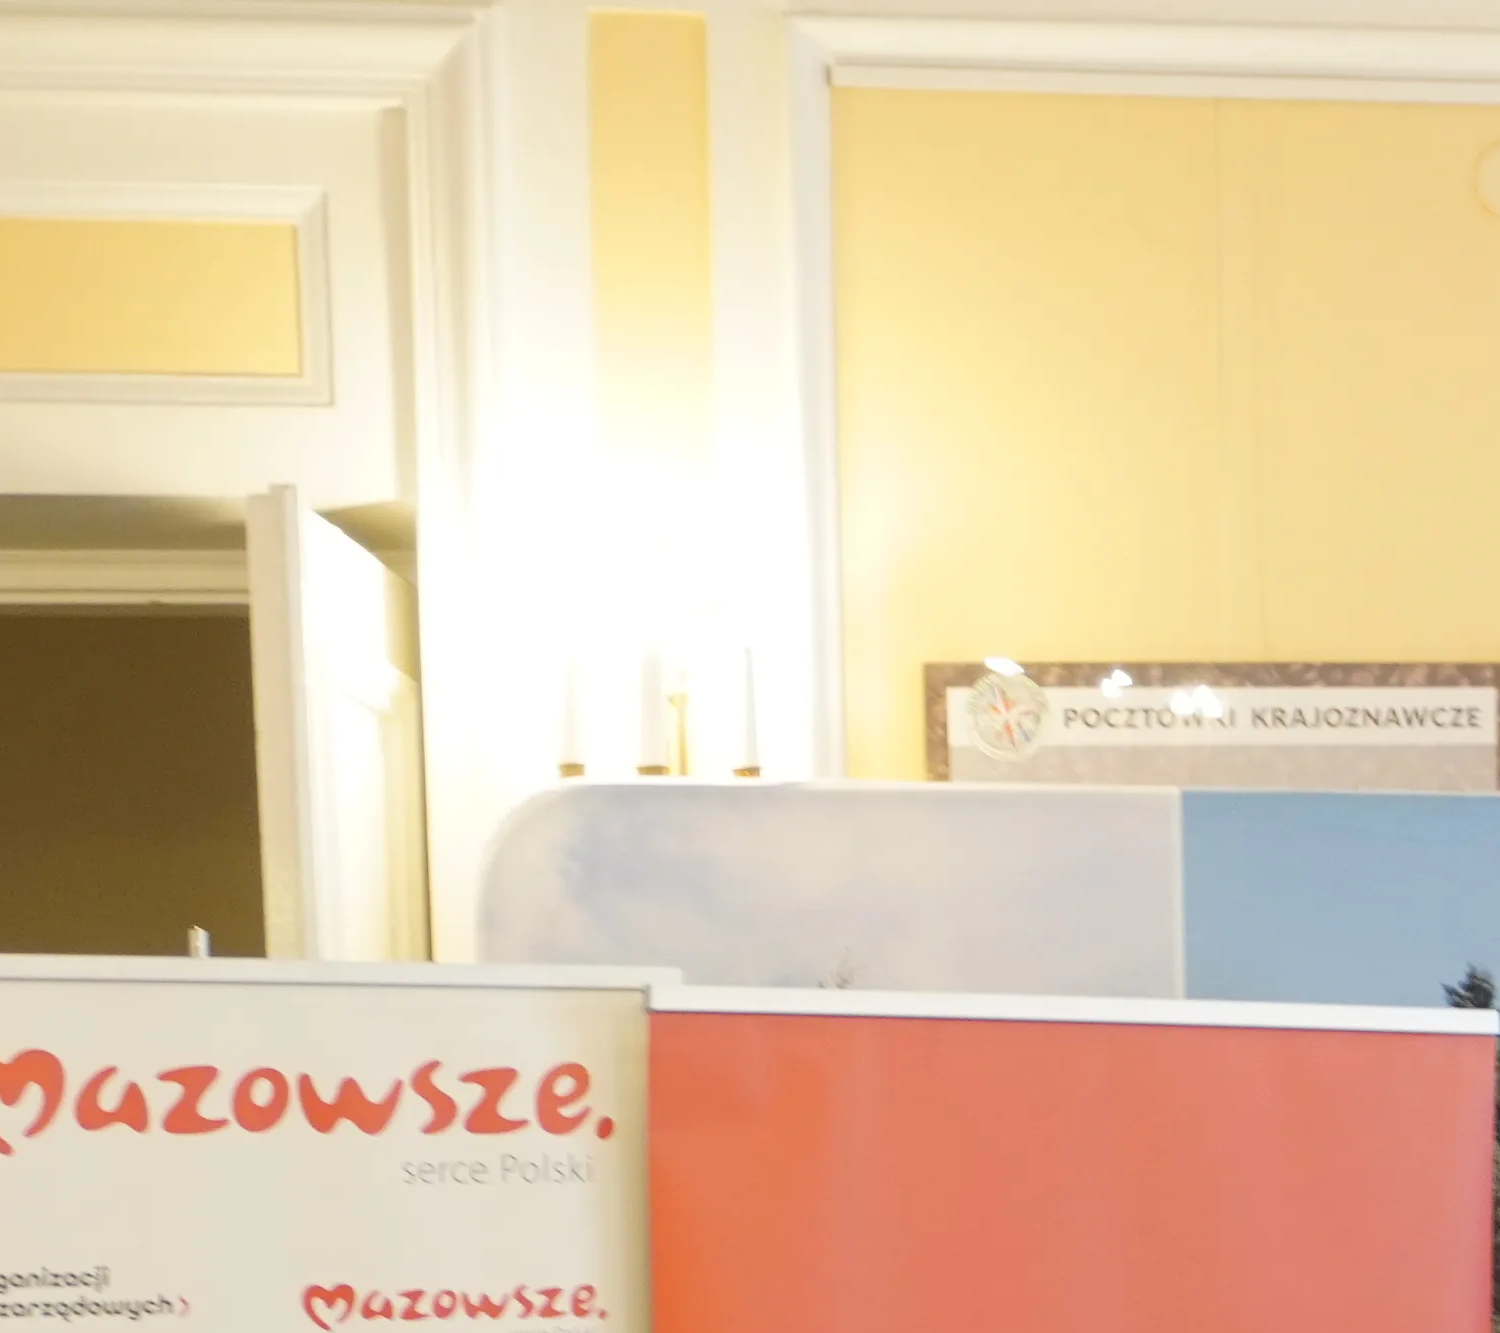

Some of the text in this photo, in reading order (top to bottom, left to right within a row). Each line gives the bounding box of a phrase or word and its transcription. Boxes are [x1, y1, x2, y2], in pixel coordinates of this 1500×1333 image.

[1251, 704, 1483, 729] KRAJOZNAWCZE
[401, 1153, 595, 1186] serce Polski
